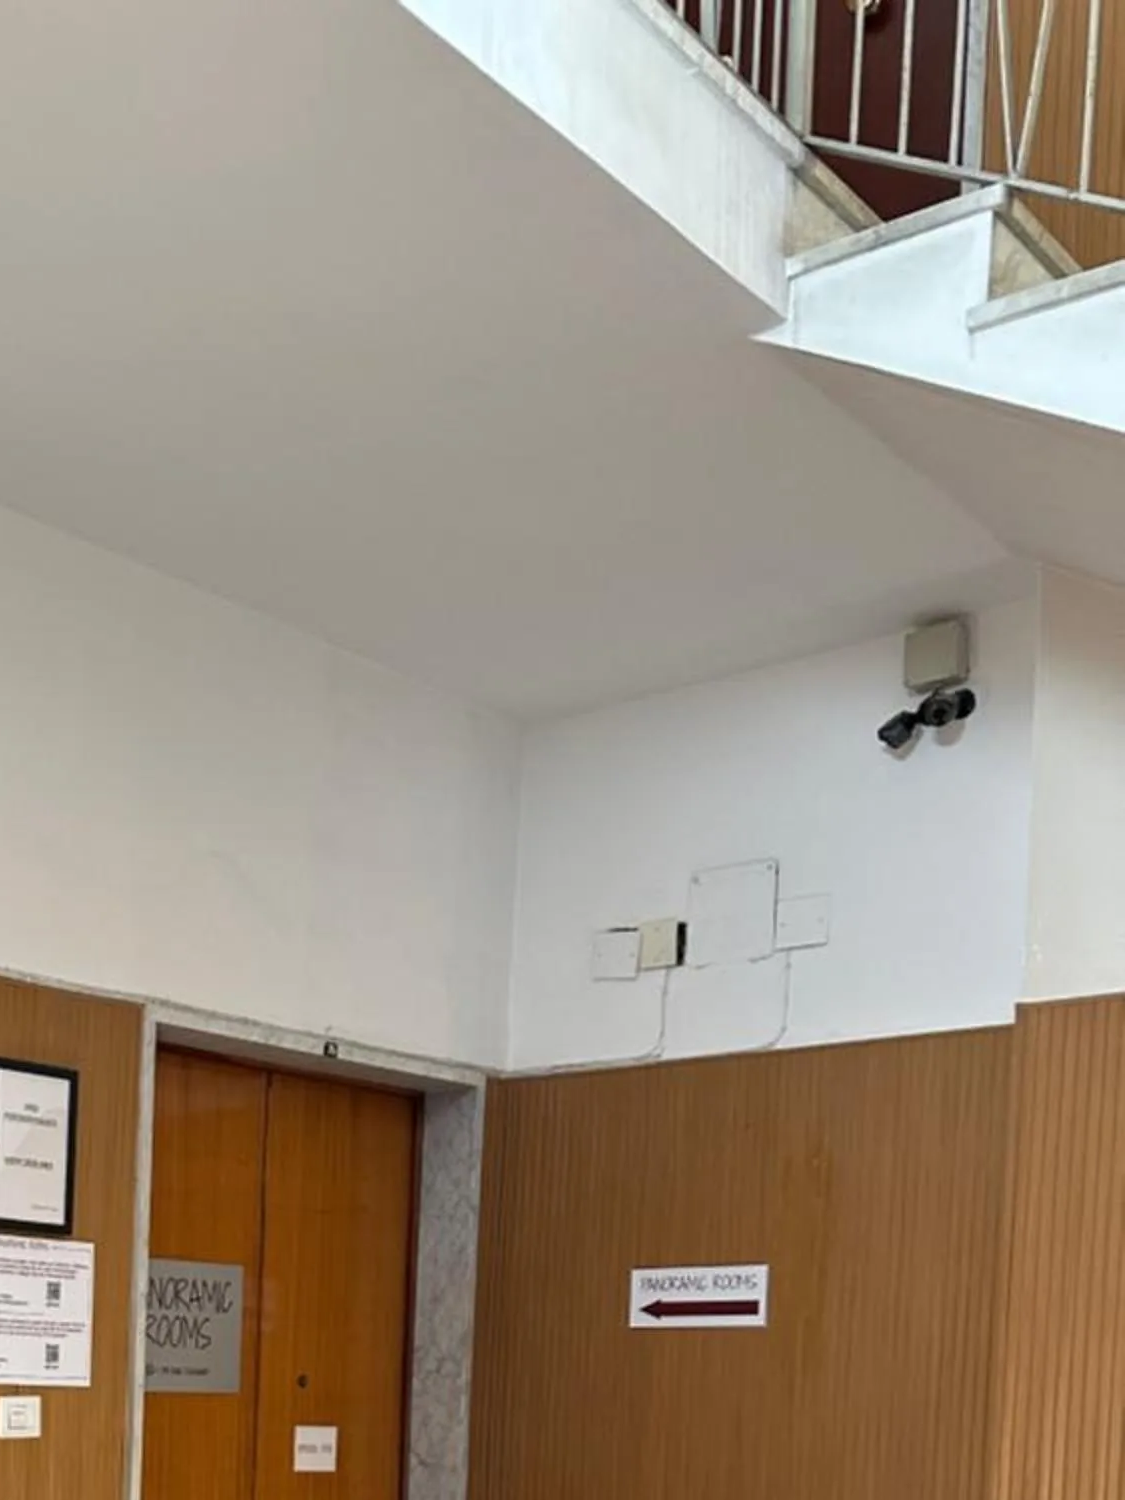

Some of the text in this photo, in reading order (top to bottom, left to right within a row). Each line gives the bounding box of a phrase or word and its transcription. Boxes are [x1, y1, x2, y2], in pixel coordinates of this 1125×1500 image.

[147, 1276, 233, 1314] NORAMIC
[639, 1272, 759, 1292] PANORAMIC ROOMS
